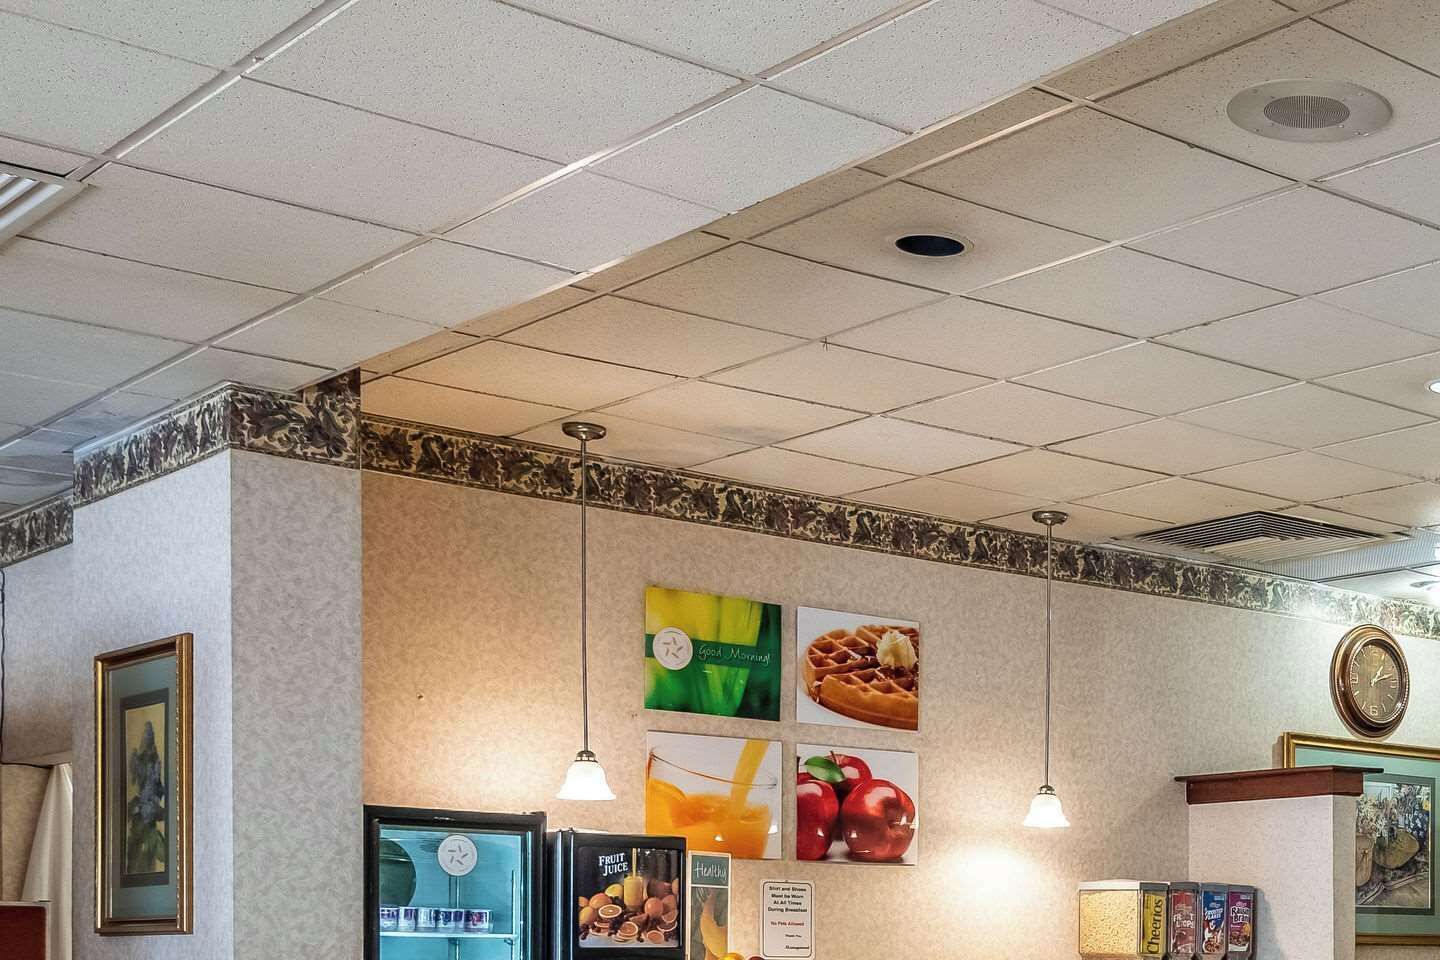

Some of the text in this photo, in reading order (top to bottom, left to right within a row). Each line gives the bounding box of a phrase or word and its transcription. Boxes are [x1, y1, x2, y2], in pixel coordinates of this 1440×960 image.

[698, 643, 771, 666] Good Morning!
[1369, 705, 1379, 716] 6
[598, 852, 626, 866] FRUIT
[602, 862, 629, 877] JUICE
[694, 861, 728, 884] Healthy
[1146, 899, 1163, 954] Cheerios
